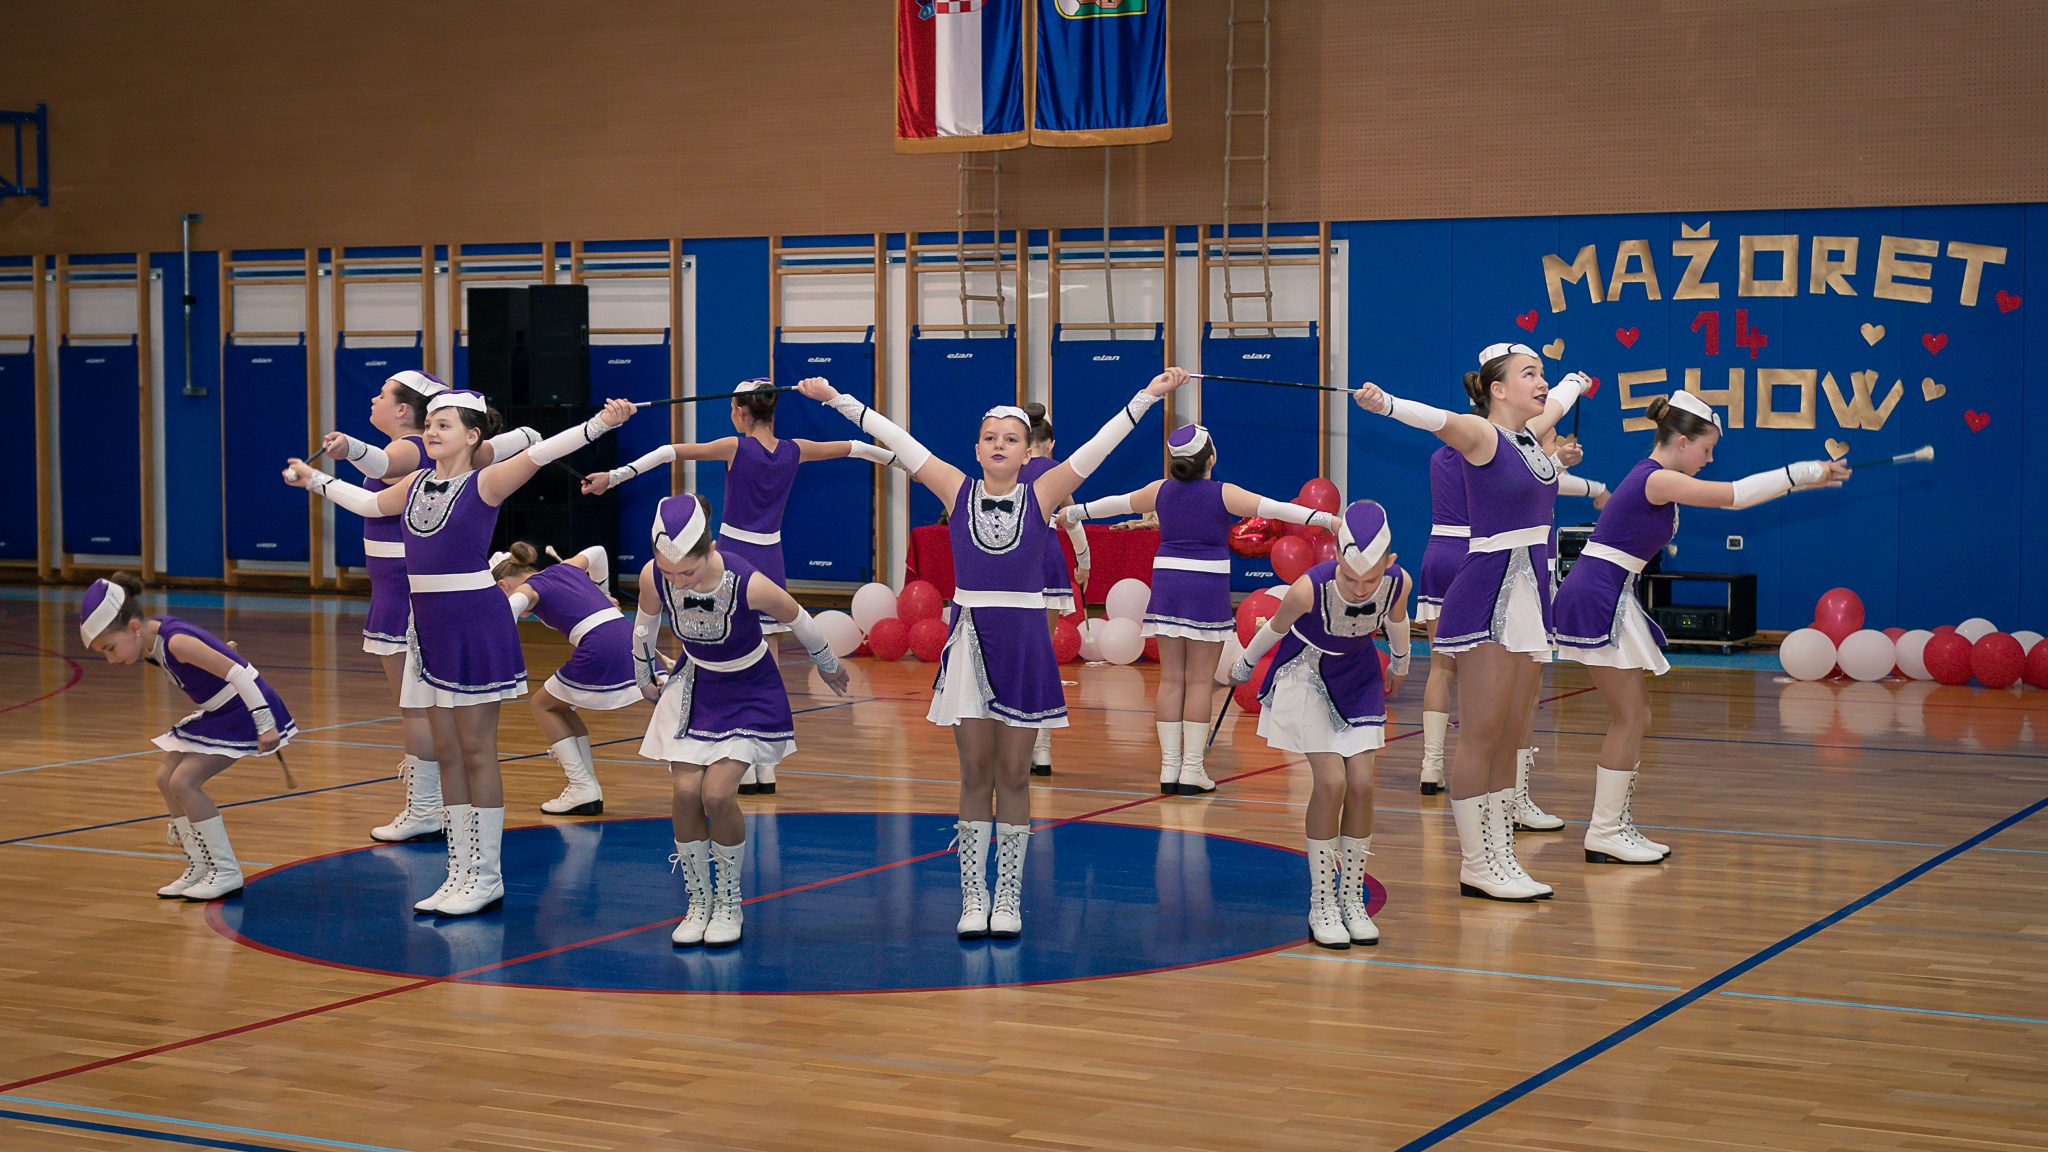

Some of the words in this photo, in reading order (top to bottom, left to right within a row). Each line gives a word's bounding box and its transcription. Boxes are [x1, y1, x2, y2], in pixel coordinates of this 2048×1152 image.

[1542, 221, 2007, 313] MAŽORET
[1691, 308, 1767, 359] 14
[1618, 367, 1905, 433] SHOW
